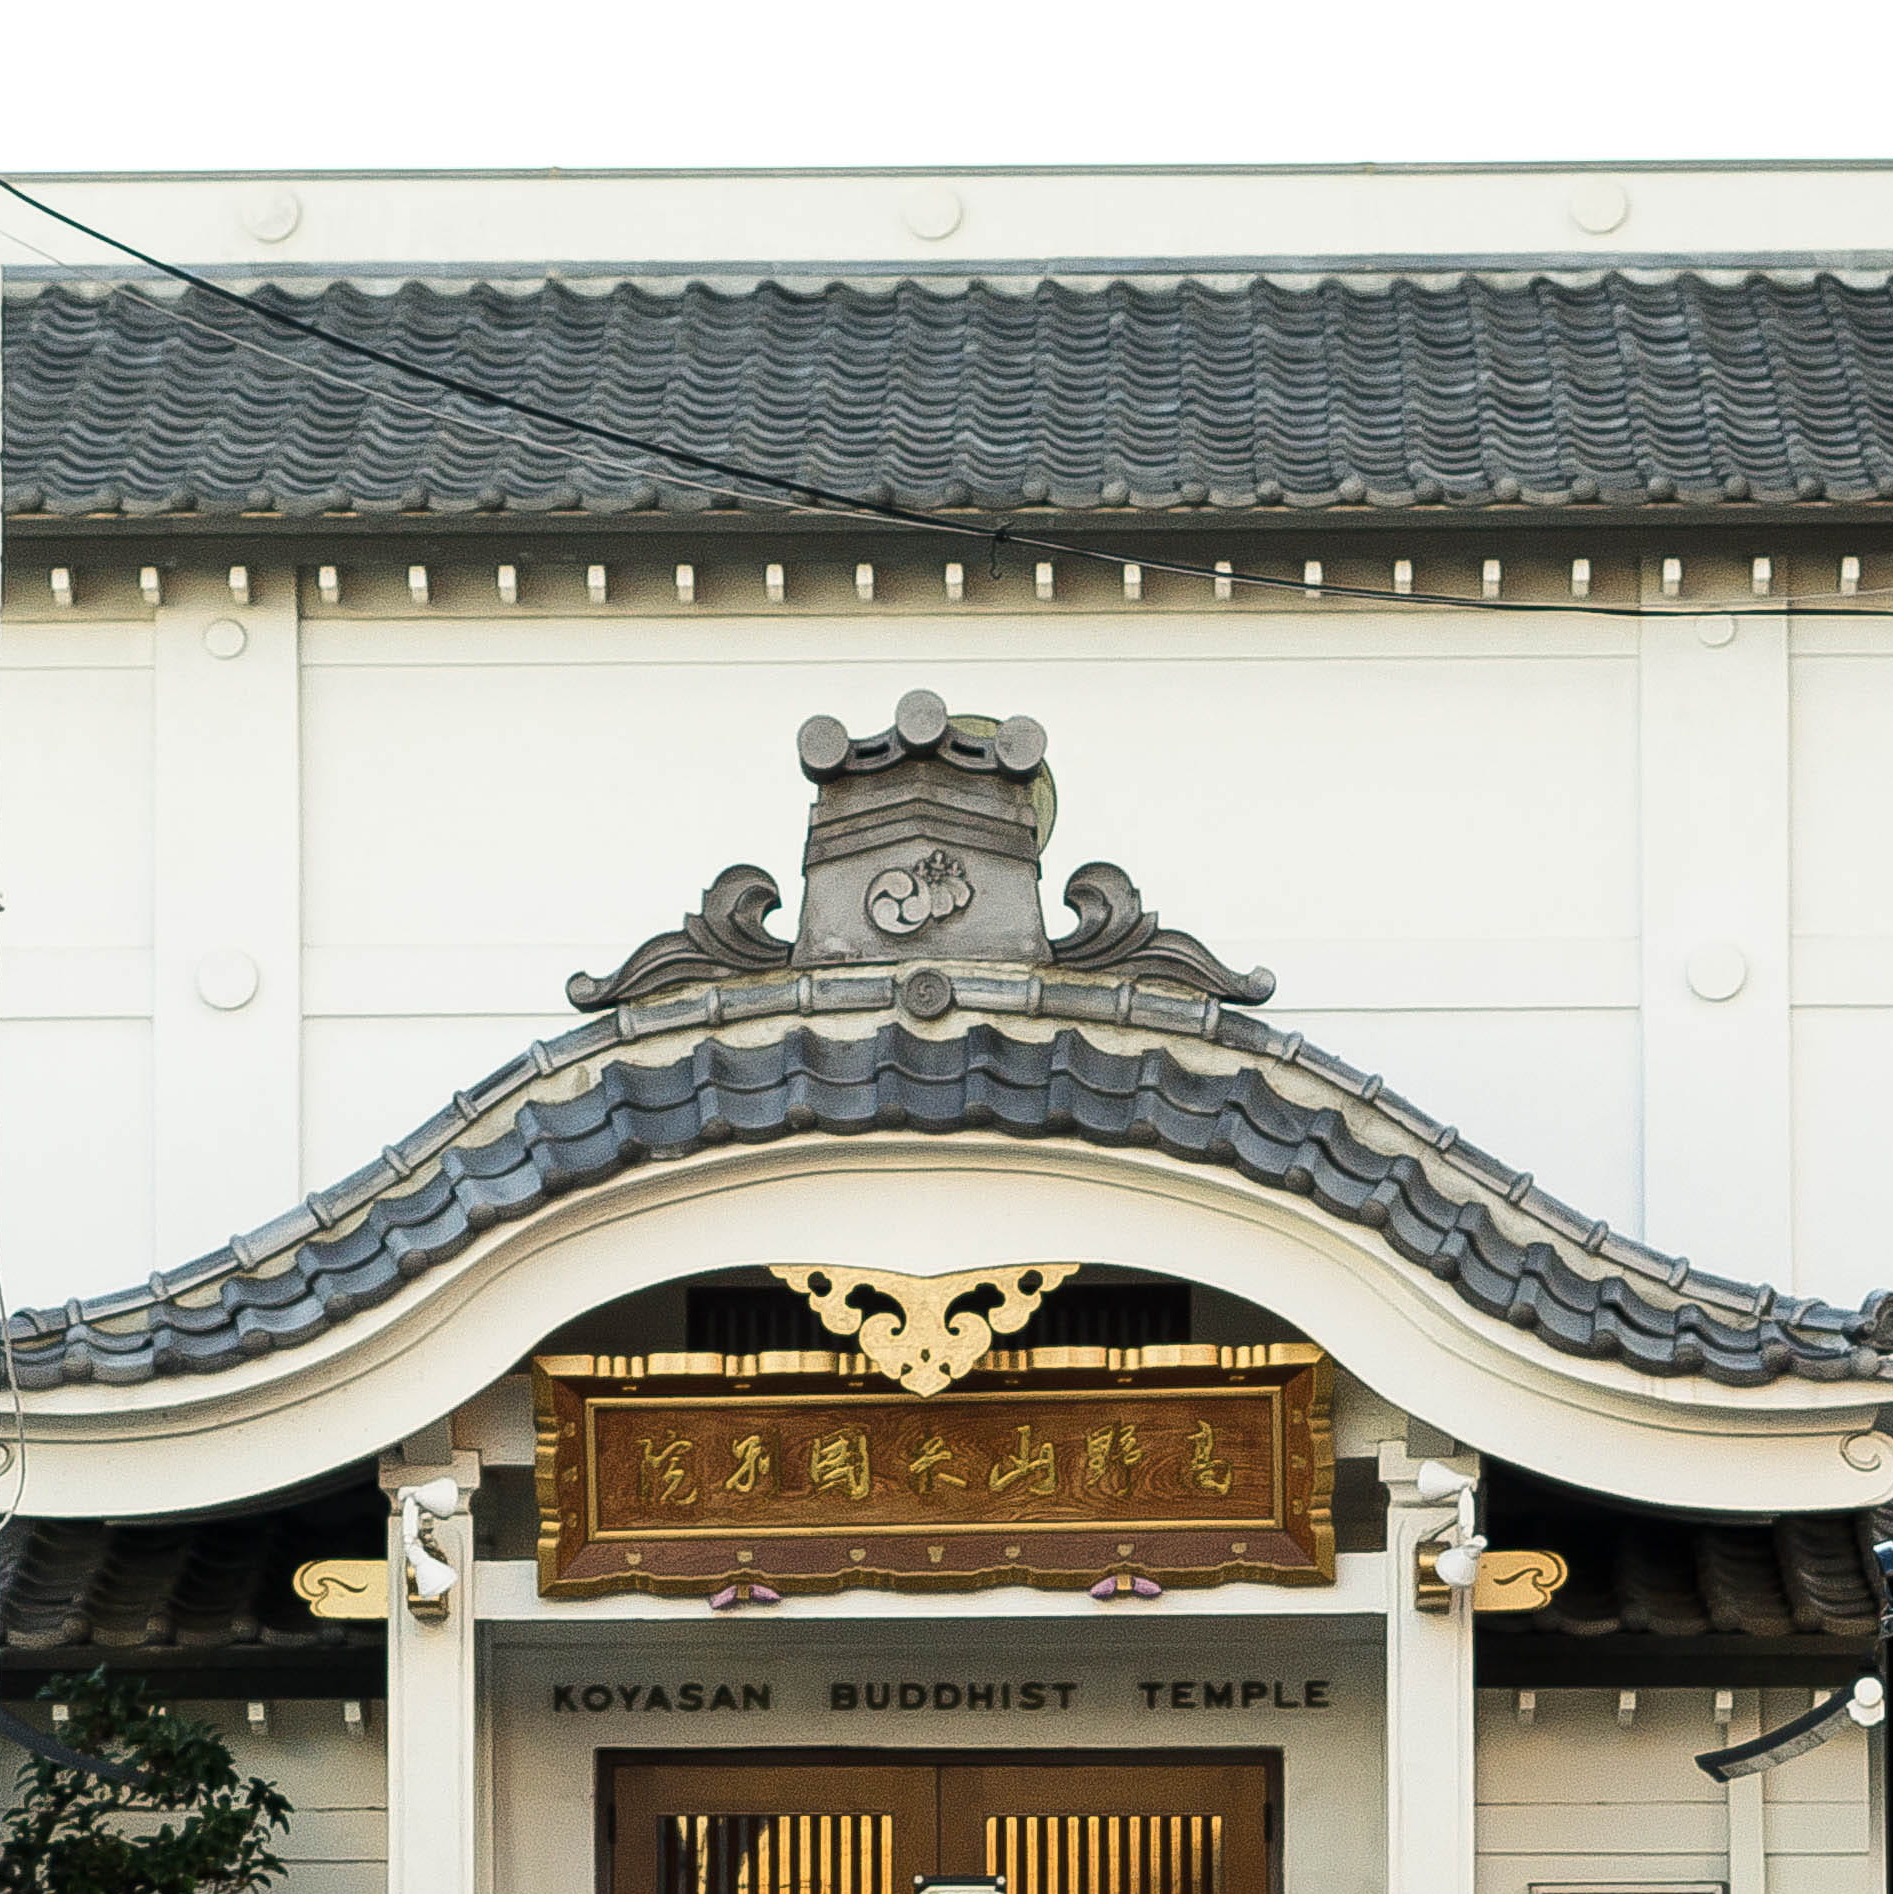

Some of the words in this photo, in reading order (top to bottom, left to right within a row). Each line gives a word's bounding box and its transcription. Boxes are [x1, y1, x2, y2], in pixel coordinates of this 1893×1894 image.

[552, 1683, 773, 1712] KOYASAN
[829, 1681, 1078, 1711] BUDDHIST
[1136, 1680, 1331, 1711] TEMPLE
